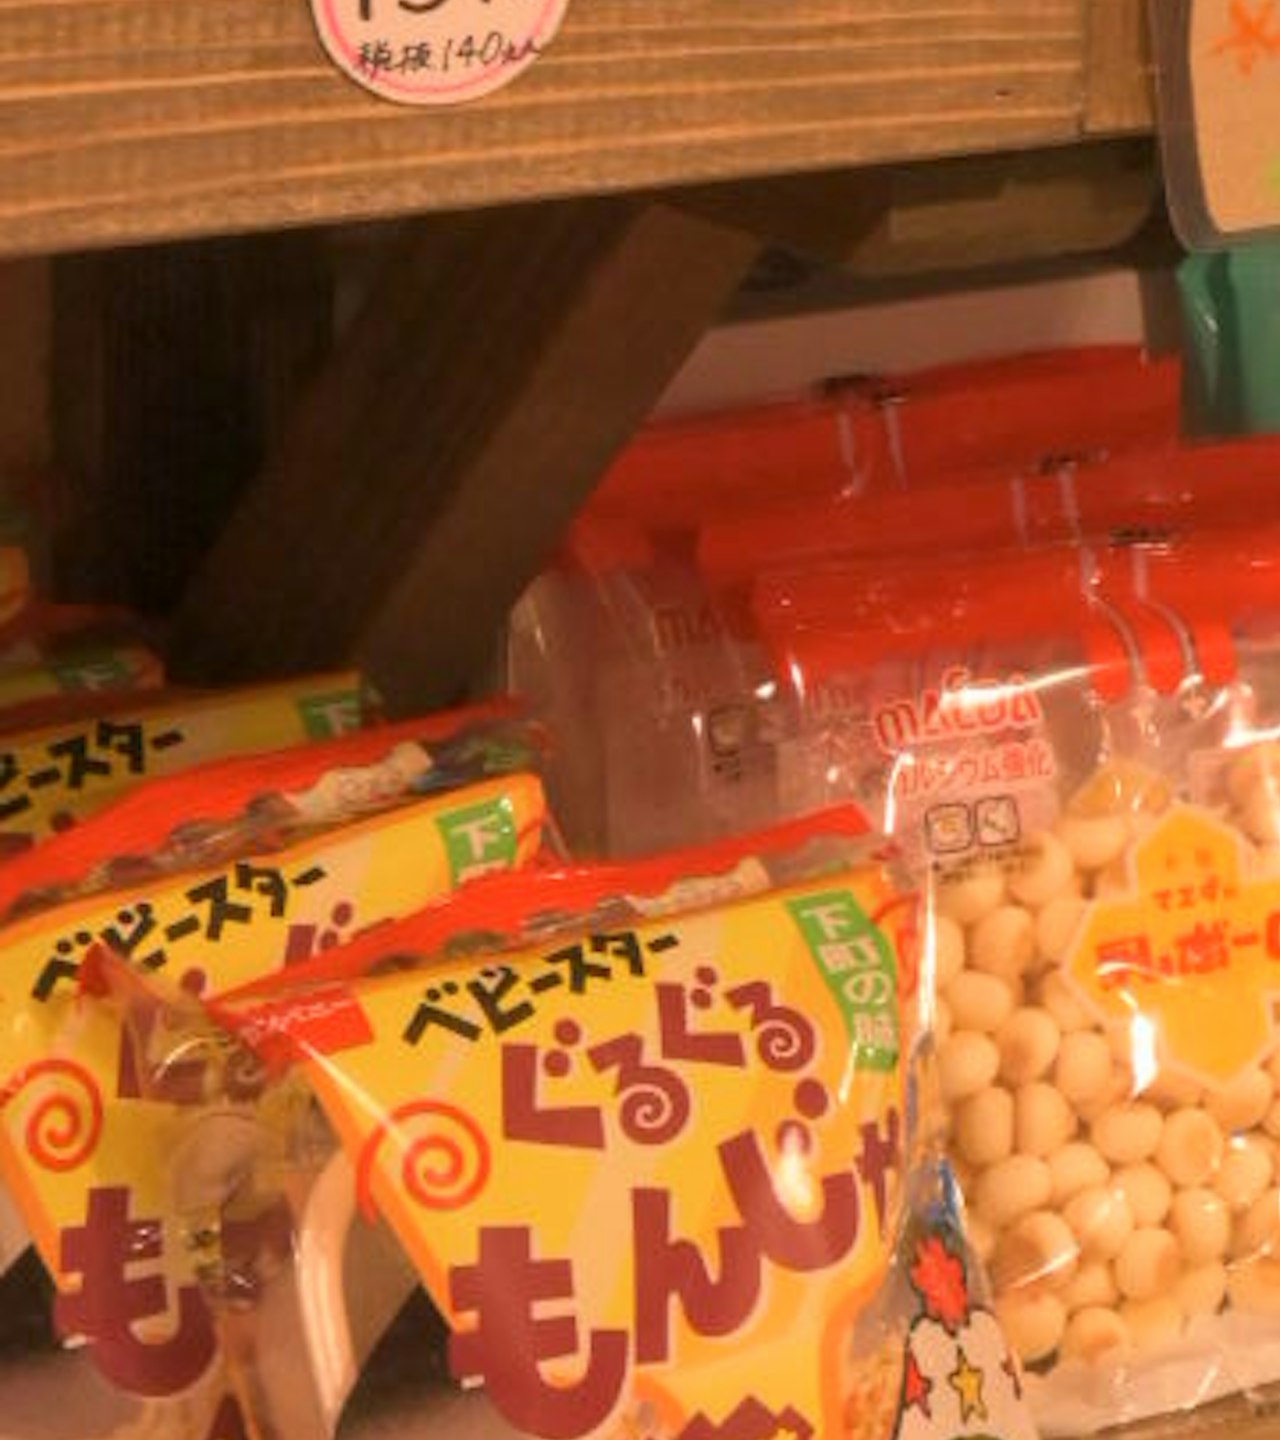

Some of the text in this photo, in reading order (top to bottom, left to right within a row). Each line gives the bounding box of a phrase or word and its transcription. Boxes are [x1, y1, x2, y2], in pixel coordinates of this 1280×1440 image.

[402, 928, 682, 1050] ベビースター
[500, 962, 822, 1152] ぐるぐる
